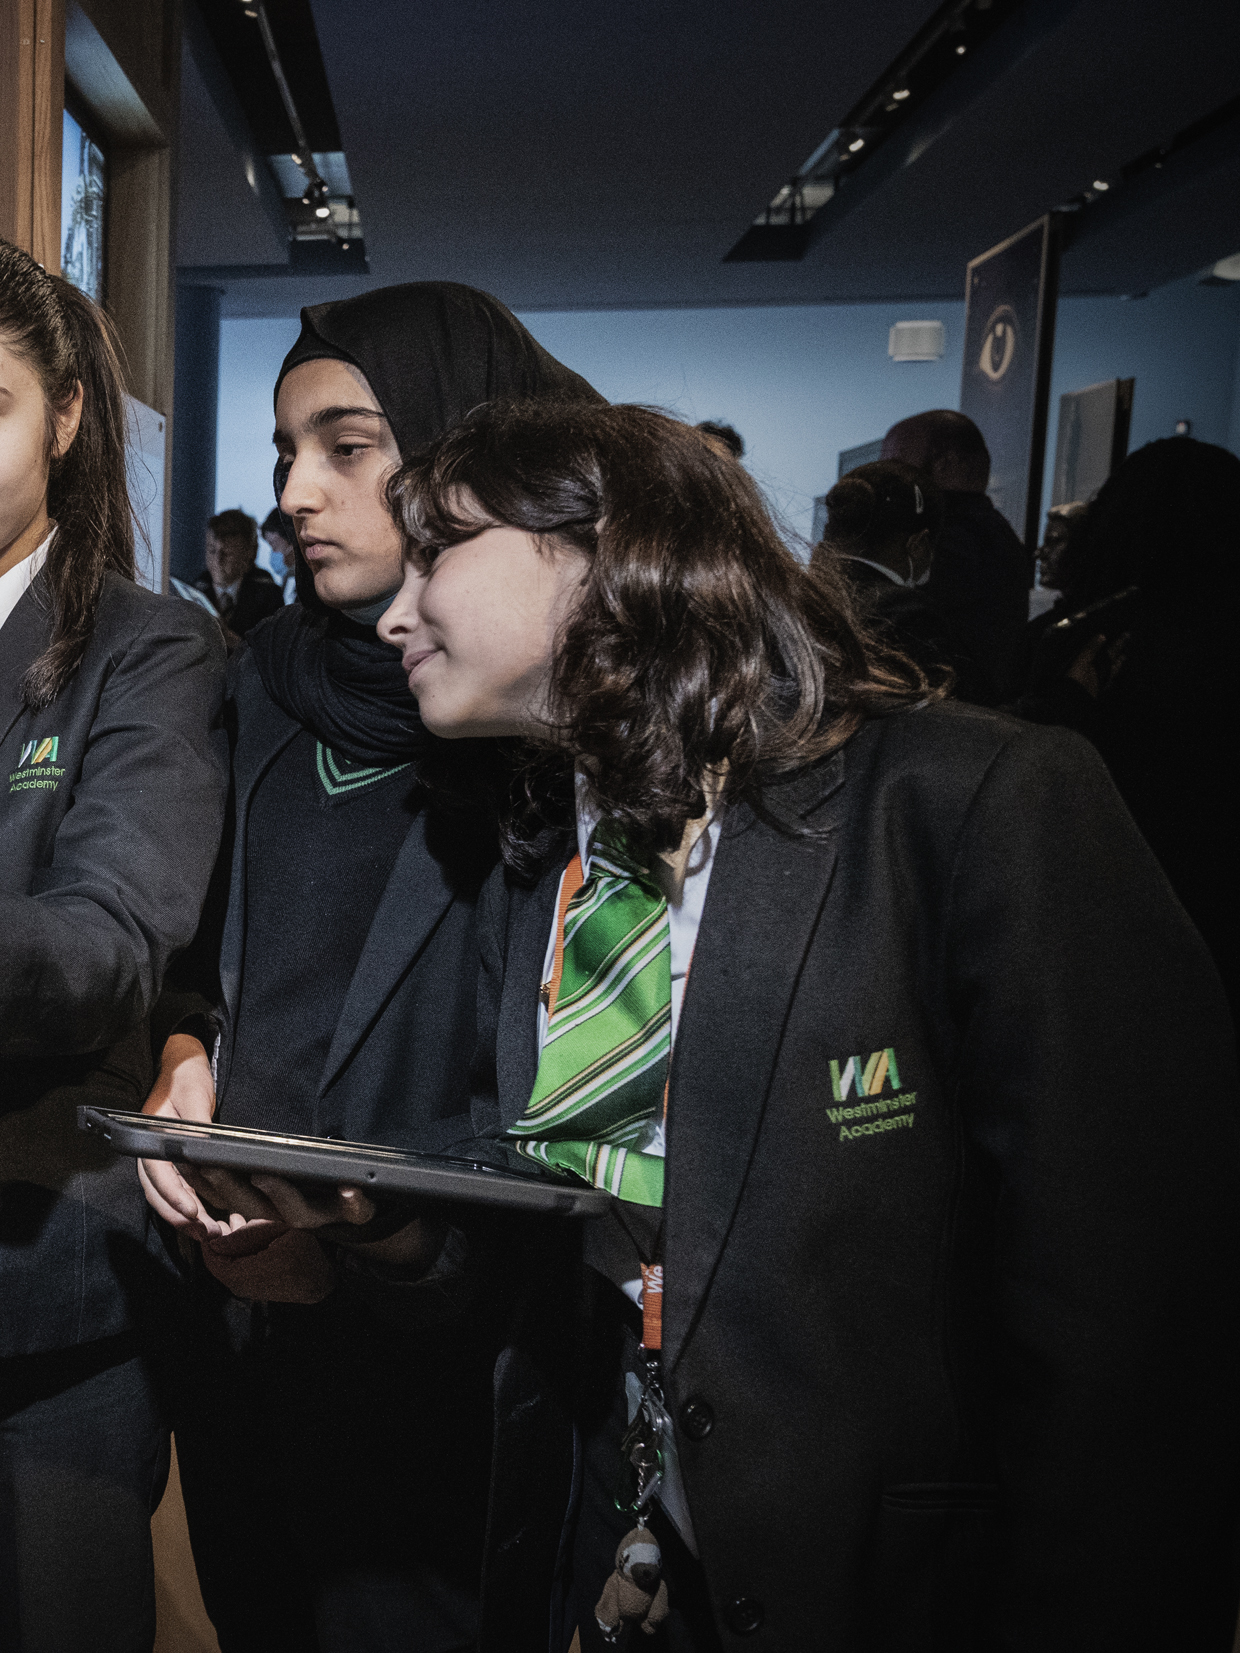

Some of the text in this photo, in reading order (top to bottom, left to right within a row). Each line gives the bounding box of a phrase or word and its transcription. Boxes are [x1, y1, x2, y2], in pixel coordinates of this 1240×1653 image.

[9, 765, 66, 783] Westminster
[9, 778, 59, 793] Academy
[825, 1091, 917, 1124] Westminster
[839, 1112, 915, 1141] Academy
